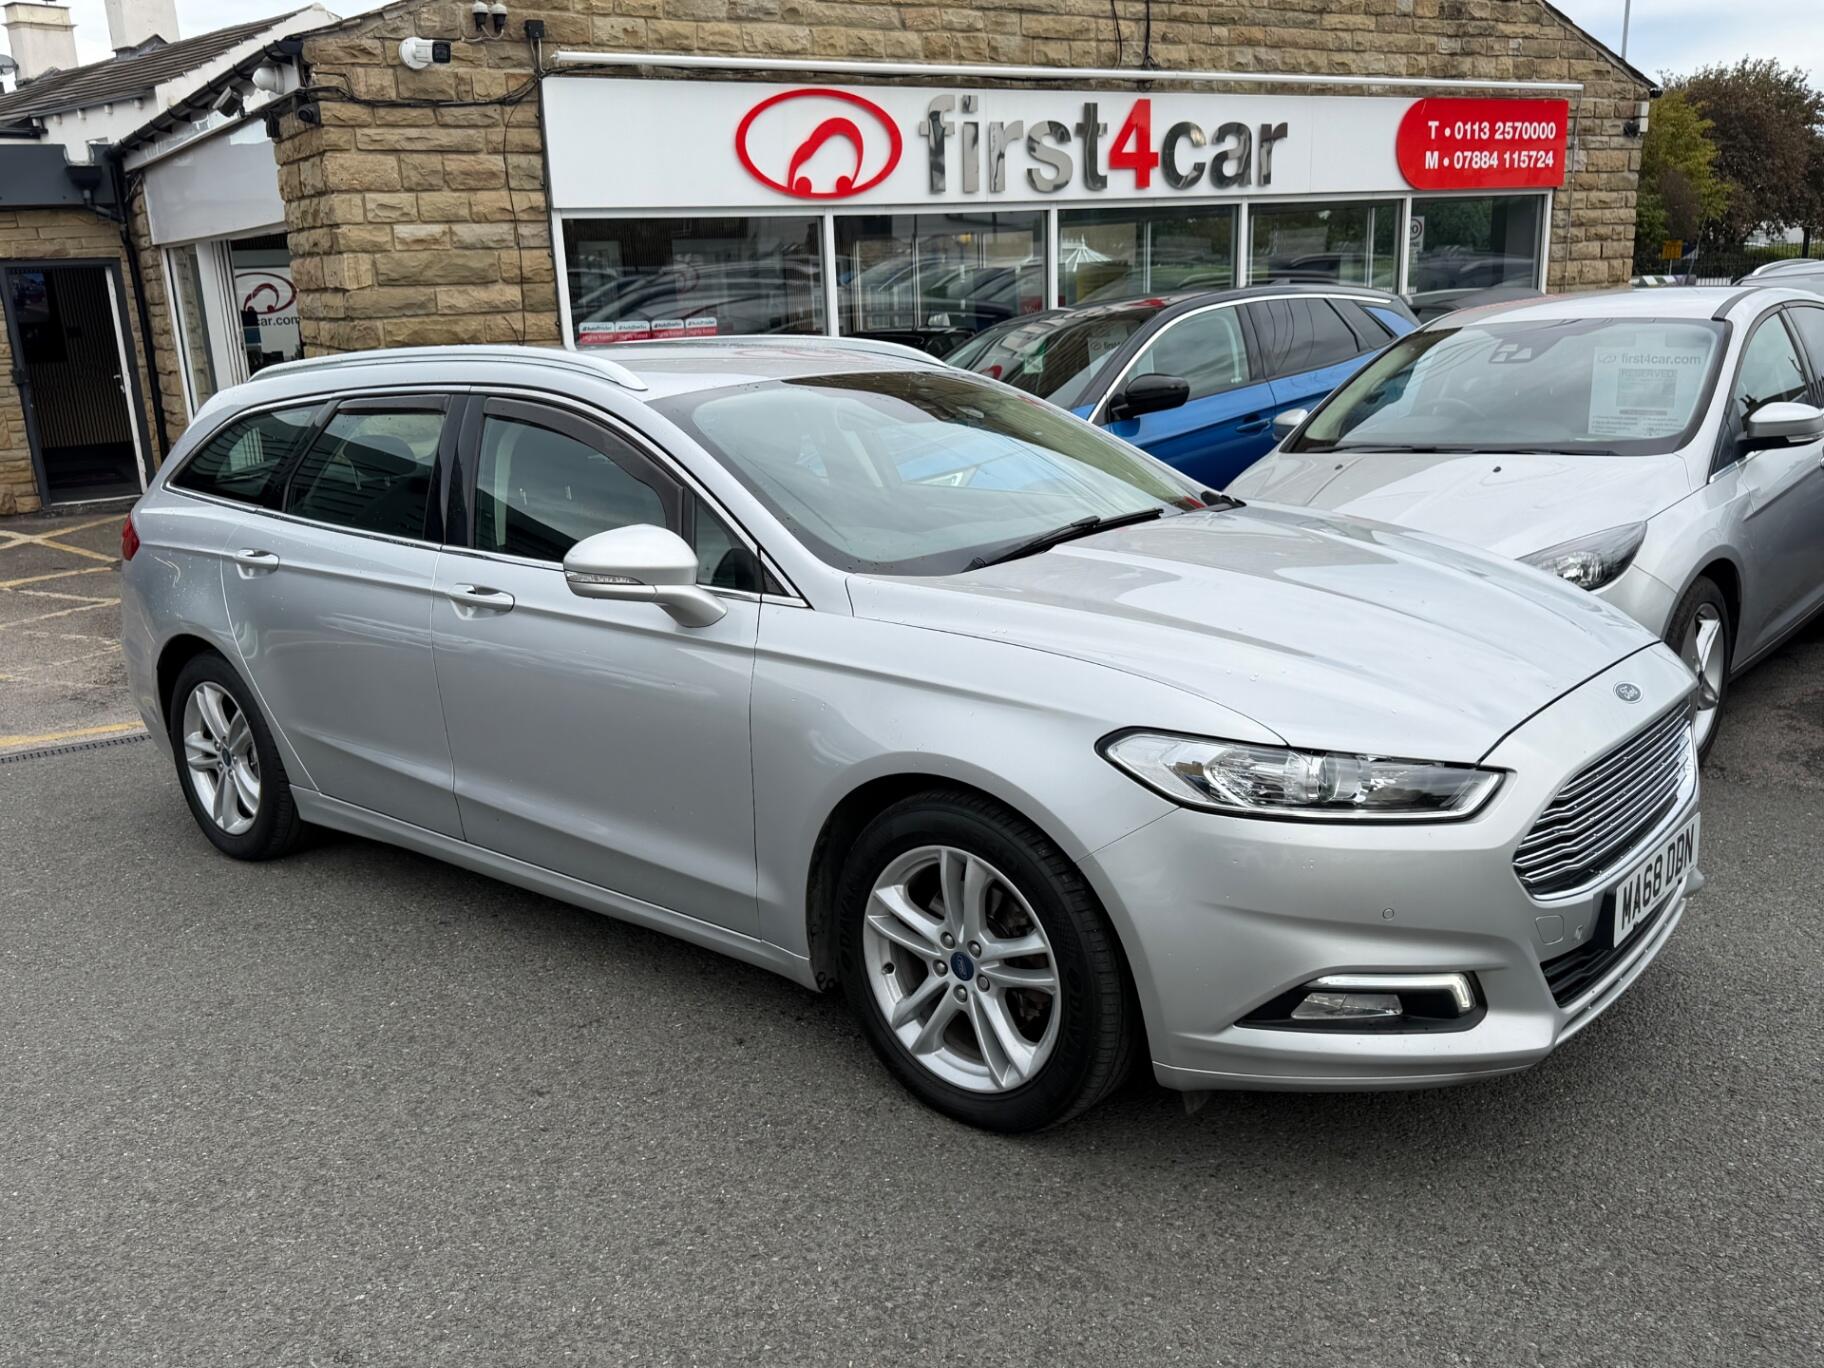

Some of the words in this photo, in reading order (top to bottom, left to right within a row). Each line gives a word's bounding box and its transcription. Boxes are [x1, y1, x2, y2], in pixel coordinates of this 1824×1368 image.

[1427, 120, 1440, 140] T
[1454, 121, 1490, 140] 0113
[1494, 121, 1557, 140] 2570000
[919, 94, 1289, 194] first4car
[1425, 150, 1439, 170] M
[1453, 150, 1499, 170] 07884
[1503, 150, 1554, 169] 115724
[258, 316, 300, 326] ar.com
[1621, 853, 1664, 931] MA68
[1665, 823, 1695, 887] DBN
